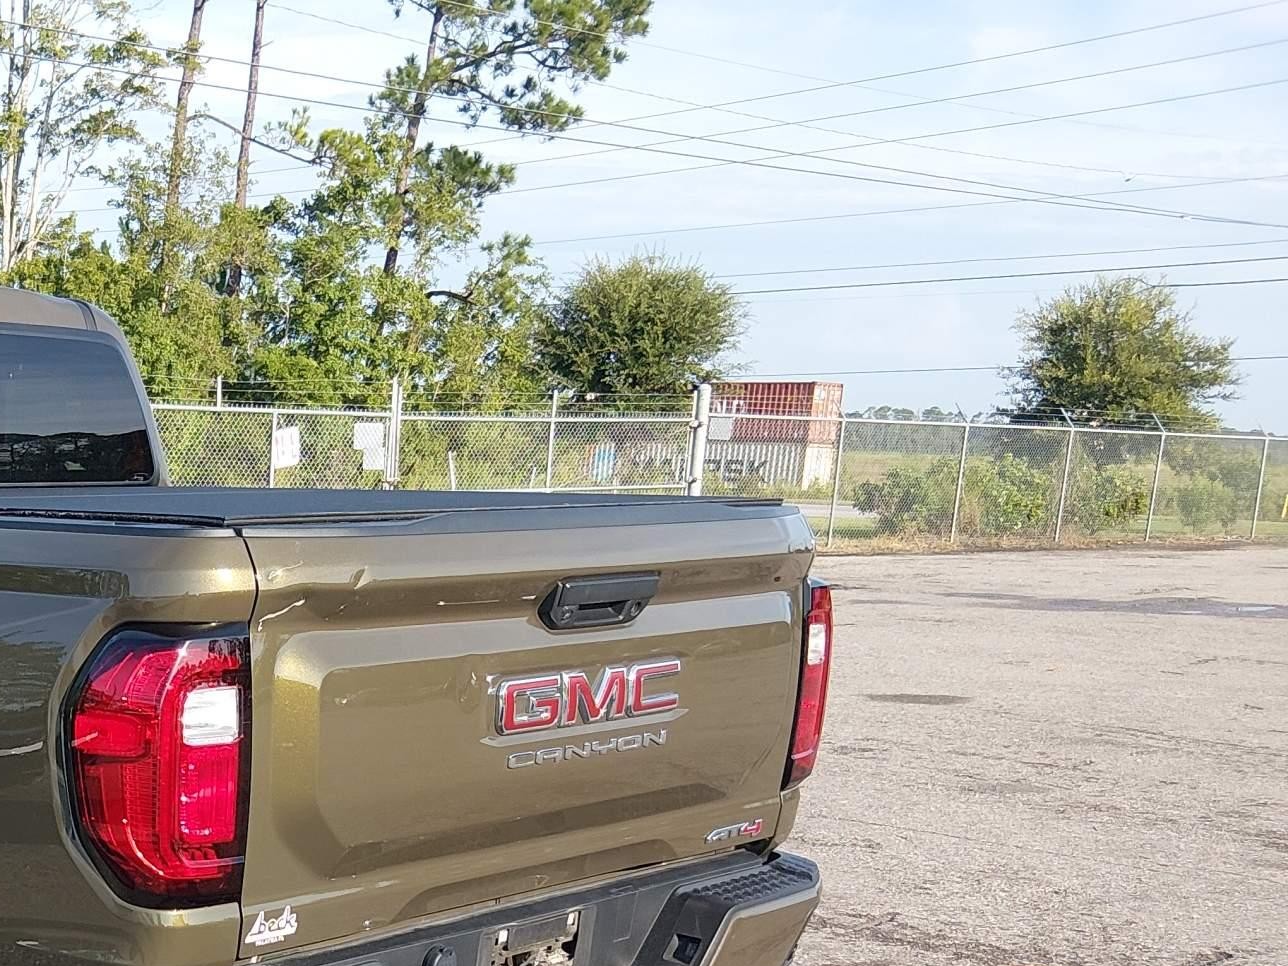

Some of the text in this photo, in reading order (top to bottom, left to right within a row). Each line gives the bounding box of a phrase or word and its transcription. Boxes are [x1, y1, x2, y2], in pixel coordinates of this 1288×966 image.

[494, 657, 681, 736] GMC
[506, 729, 668, 769] CANYON
[704, 818, 764, 844] AT4
